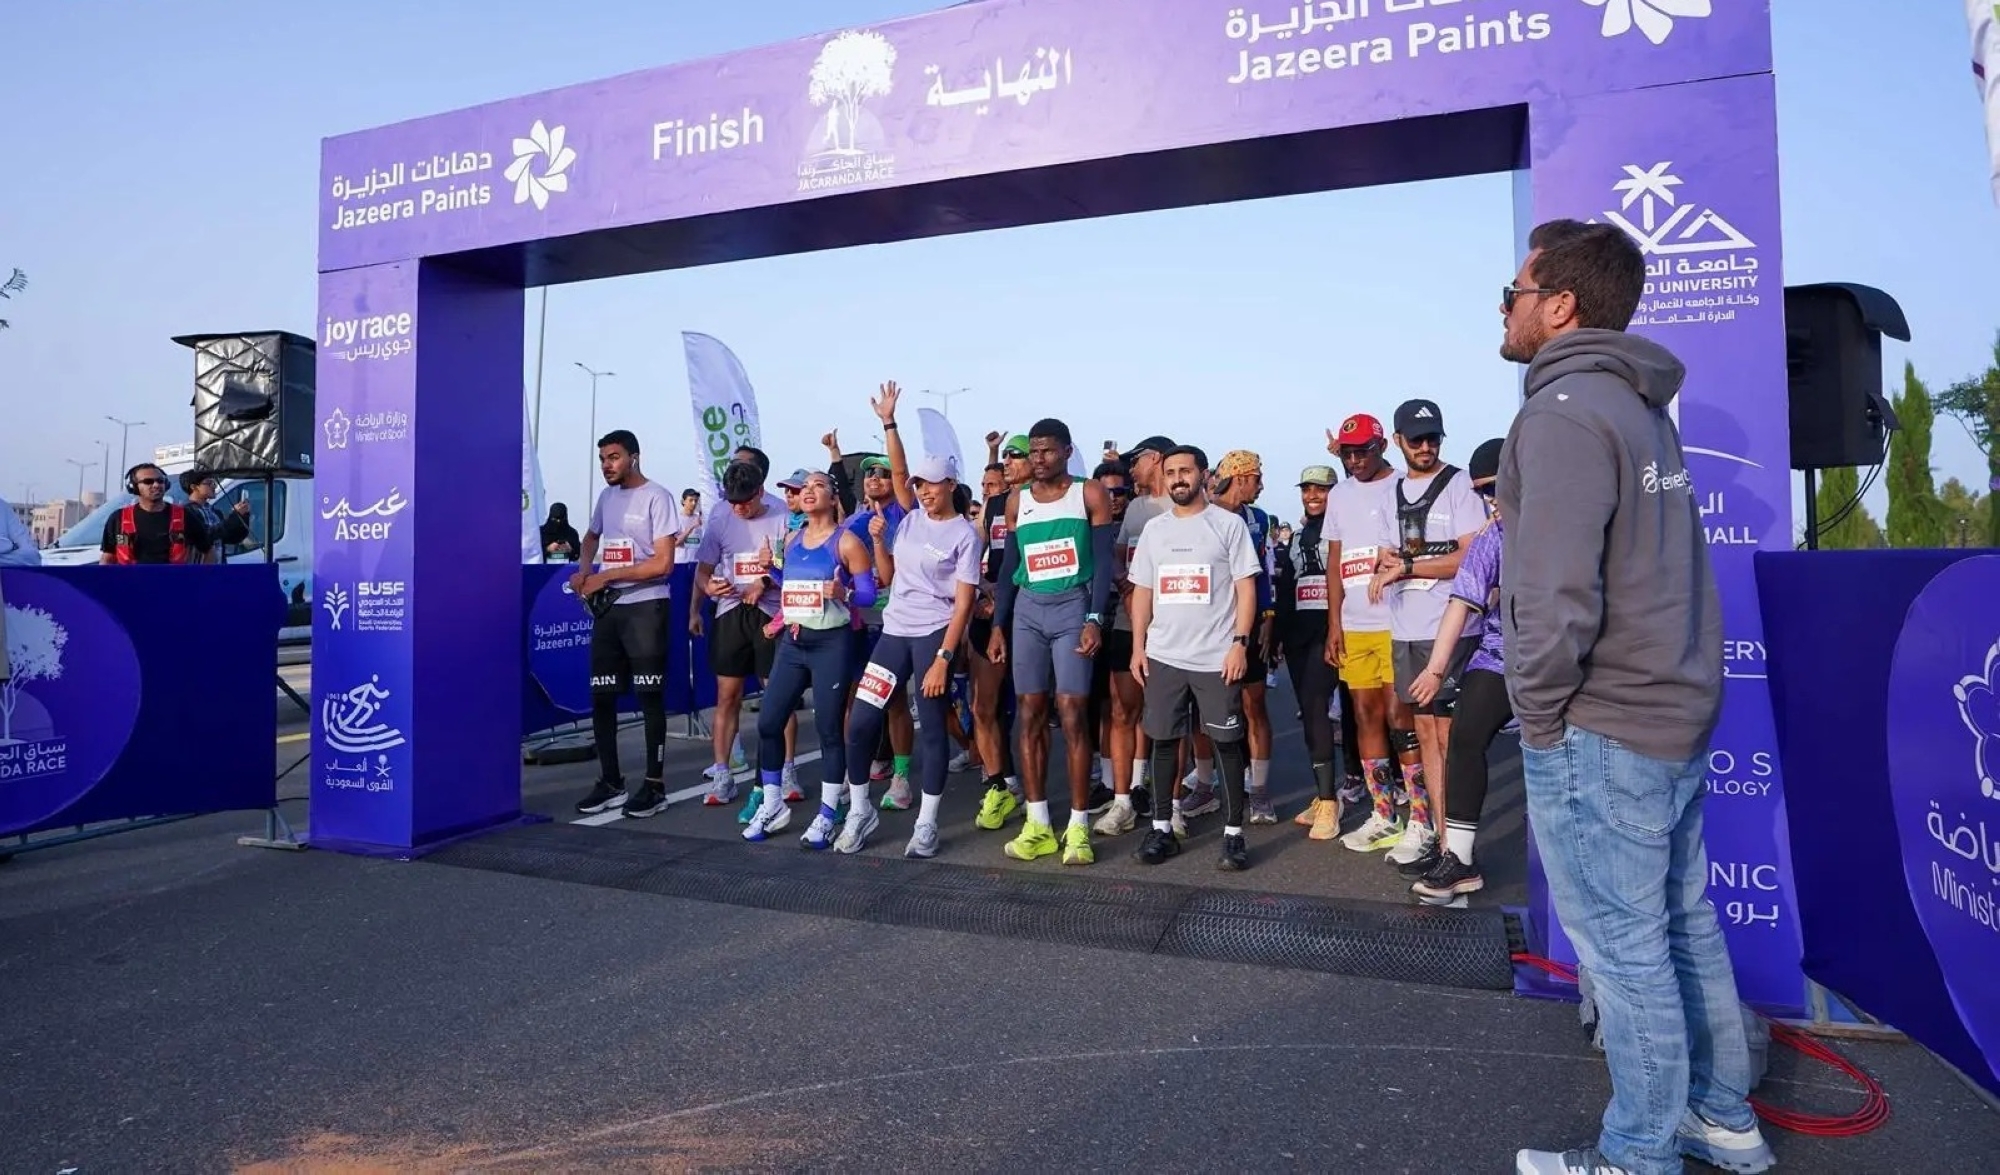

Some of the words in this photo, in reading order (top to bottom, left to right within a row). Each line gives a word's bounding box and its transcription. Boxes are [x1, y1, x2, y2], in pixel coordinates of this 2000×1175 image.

[1227, 37, 1393, 84] Jazeera
[1408, 11, 1552, 58] Paints
[924, 47, 1072, 116] النهاية
[652, 108, 764, 160] Finish
[411, 151, 493, 183] دهانات
[332, 162, 405, 200] الجزيرة
[798, 172, 863, 191] JACARANDA
[864, 166, 895, 181] RACE
[331, 199, 415, 230] Jazeera
[421, 183, 491, 215] Paints
[1675, 254, 1759, 274] جامعة
[1659, 275, 1758, 294] UNIVERSITY
[324, 316, 358, 347] joy
[361, 312, 411, 340] race
[381, 339, 411, 360] جوي
[703, 406, 730, 486] ace
[335, 519, 392, 540] Aseer
[1704, 526, 1758, 544] ALL
[741, 564, 766, 574] 2105
[1034, 554, 1069, 568] 21100
[1344, 562, 1371, 575] 21104
[358, 581, 405, 596] SUSF
[1167, 579, 1201, 591] 21054
[534, 638, 573, 651] Jazeera
[590, 675, 616, 686] AIN
[27, 756, 66, 774] RACE
[1706, 779, 1771, 797] LOGY
[1710, 861, 1779, 891] NIC
[1932, 860, 2000, 932] Minist
[1726, 899, 1779, 928] برو
